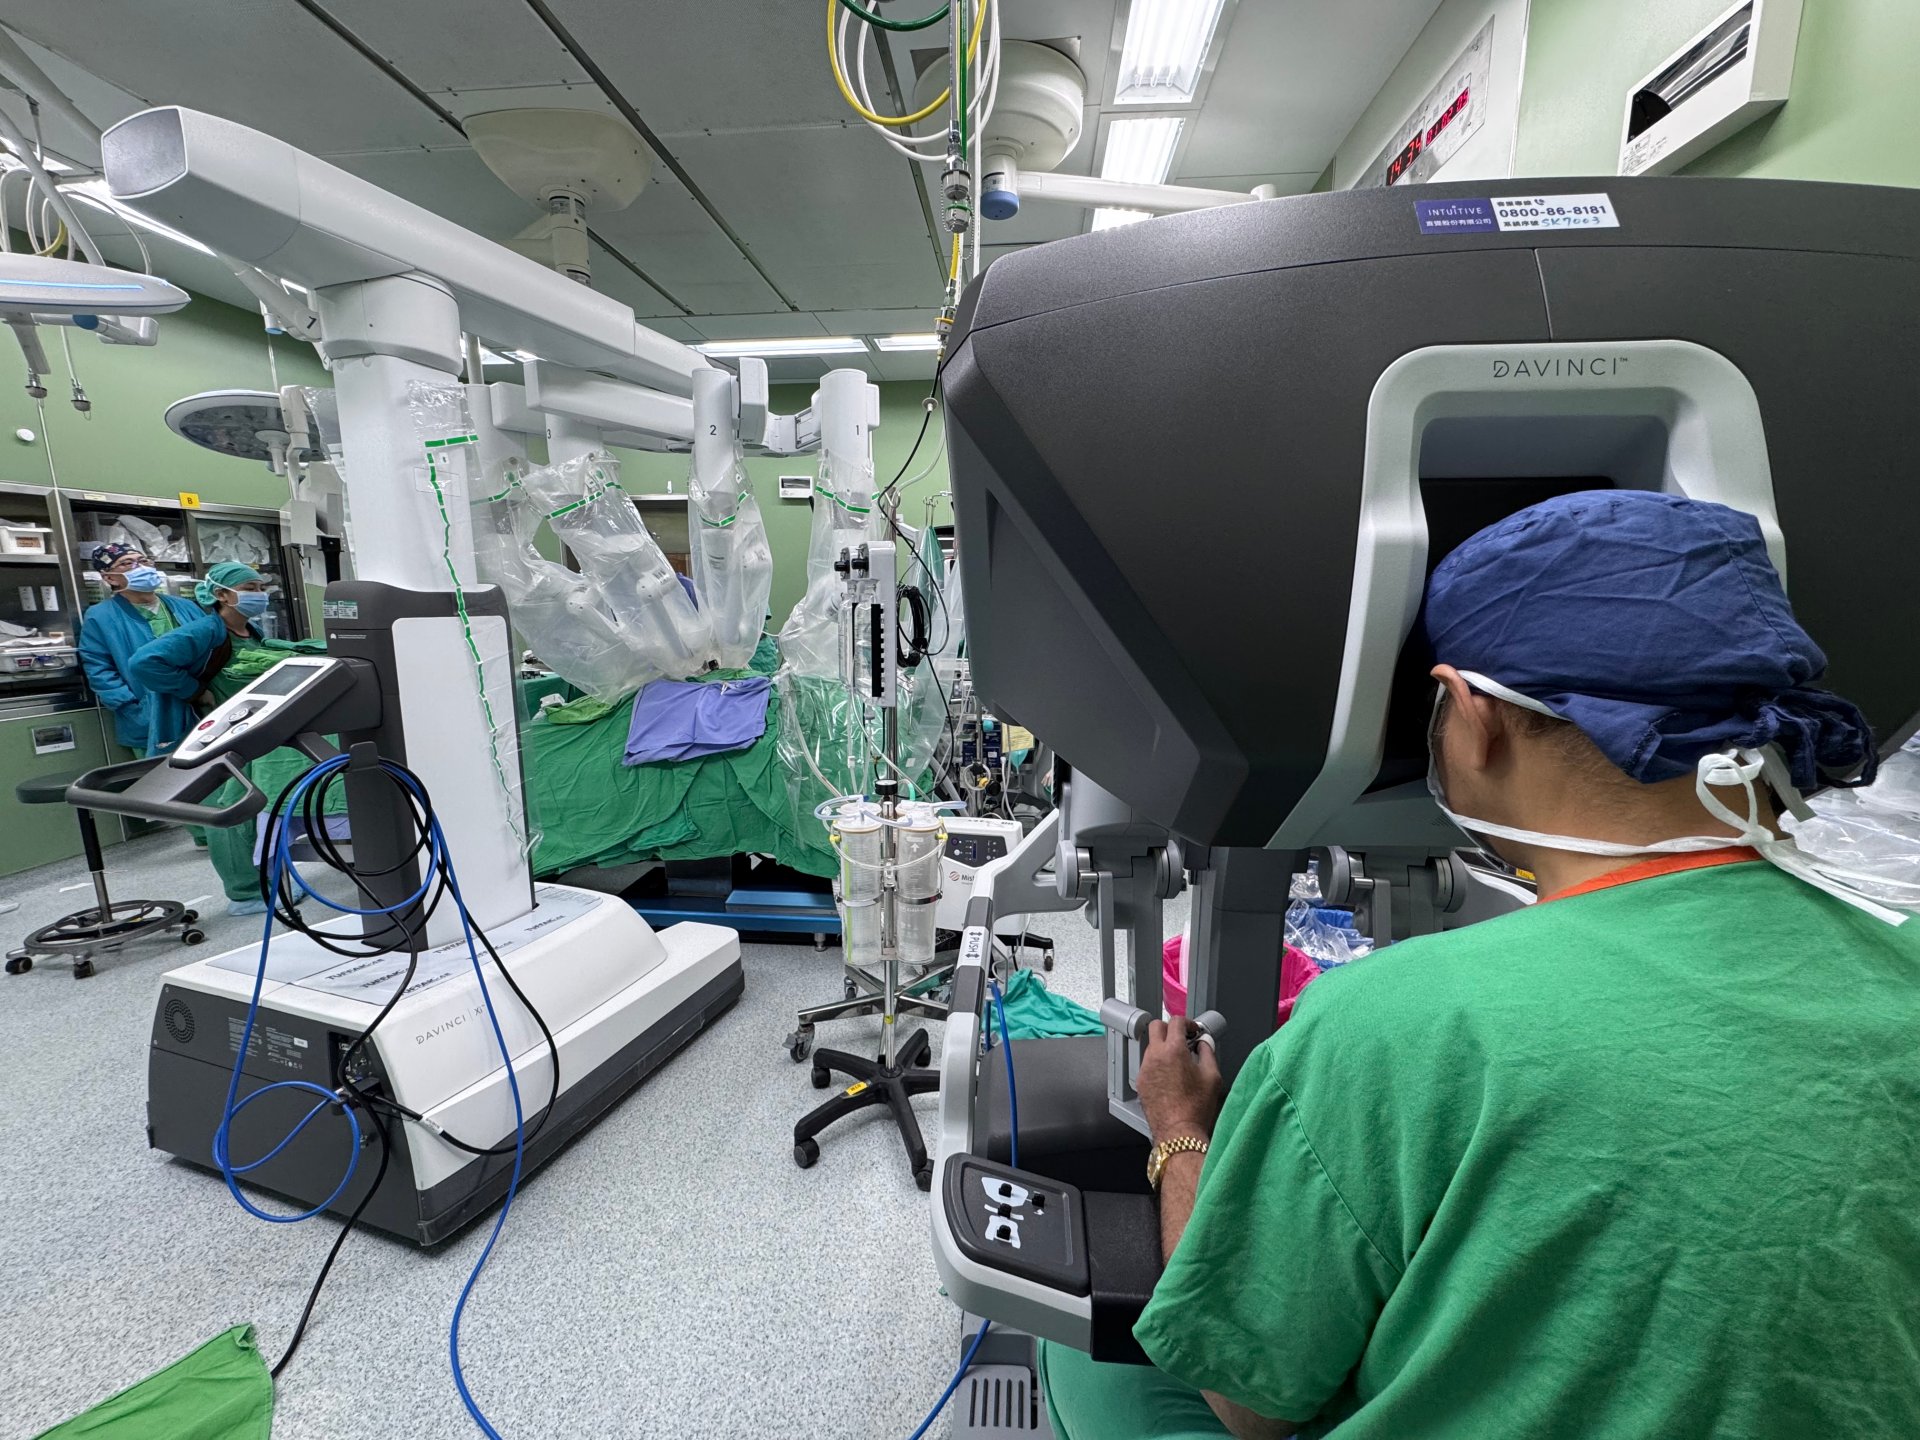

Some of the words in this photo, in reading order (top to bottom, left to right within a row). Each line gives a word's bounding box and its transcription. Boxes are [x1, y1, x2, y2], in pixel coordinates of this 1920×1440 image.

[1499, 205, 1606, 218] 0800-86-8181
[546, 428, 552, 440] 3
[709, 424, 717, 436] 2
[187, 497, 193, 505] B
[968, 937, 980, 953] PUSH
[415, 1014, 466, 1044] DAVINCI
